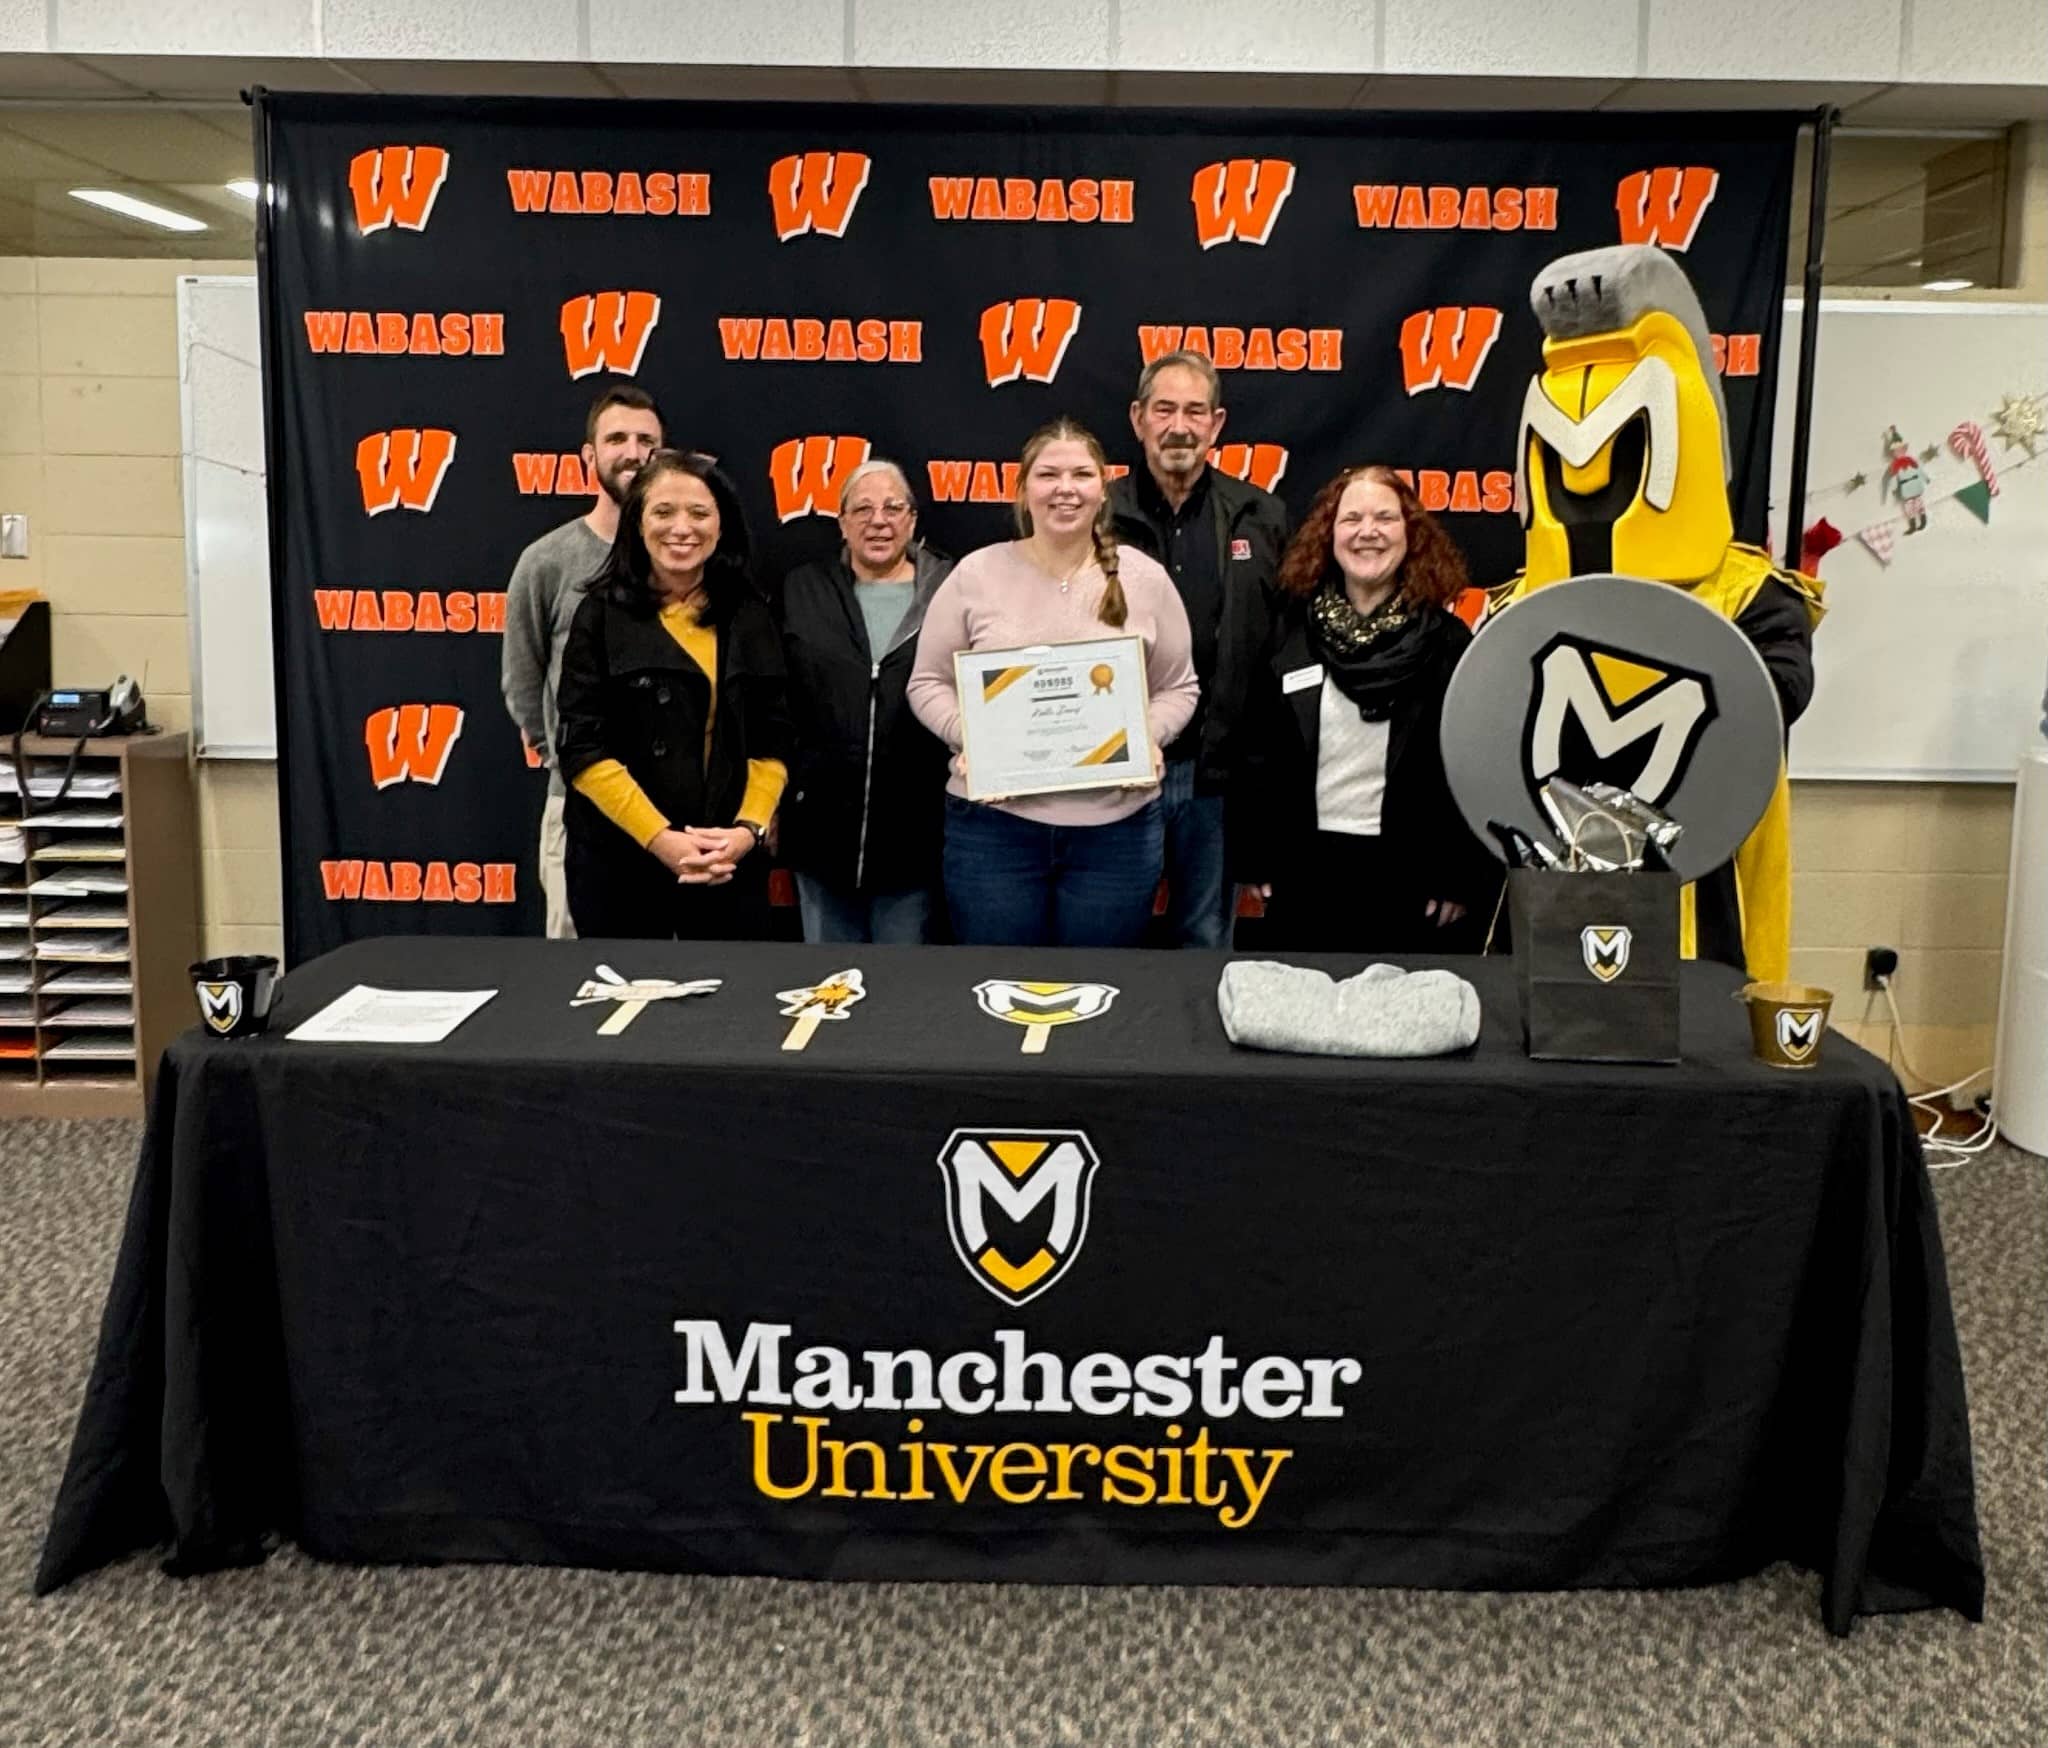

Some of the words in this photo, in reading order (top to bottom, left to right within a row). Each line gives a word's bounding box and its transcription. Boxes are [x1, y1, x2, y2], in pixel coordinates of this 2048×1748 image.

[349, 146, 450, 235] W
[507, 169, 711, 215] WABASH
[768, 152, 871, 242] W
[929, 176, 1135, 223] WABASH
[1191, 159, 1296, 250] W
[1353, 184, 1558, 230] WABASH
[1615, 166, 1719, 254] W
[304, 311, 504, 355] WABASH
[560, 291, 661, 380] W
[718, 317, 922, 363] WABASH
[979, 298, 1082, 388] W
[1399, 307, 1503, 396] W
[356, 429, 457, 517] W
[769, 436, 872, 524] W
[314, 589, 509, 633] WABASH
[365, 704, 464, 790] W
[320, 860, 516, 903] WABASH
[952, 1139, 1085, 1255] M
[674, 1320, 1362, 1420] Manchester
[742, 1412, 1293, 1528] University
